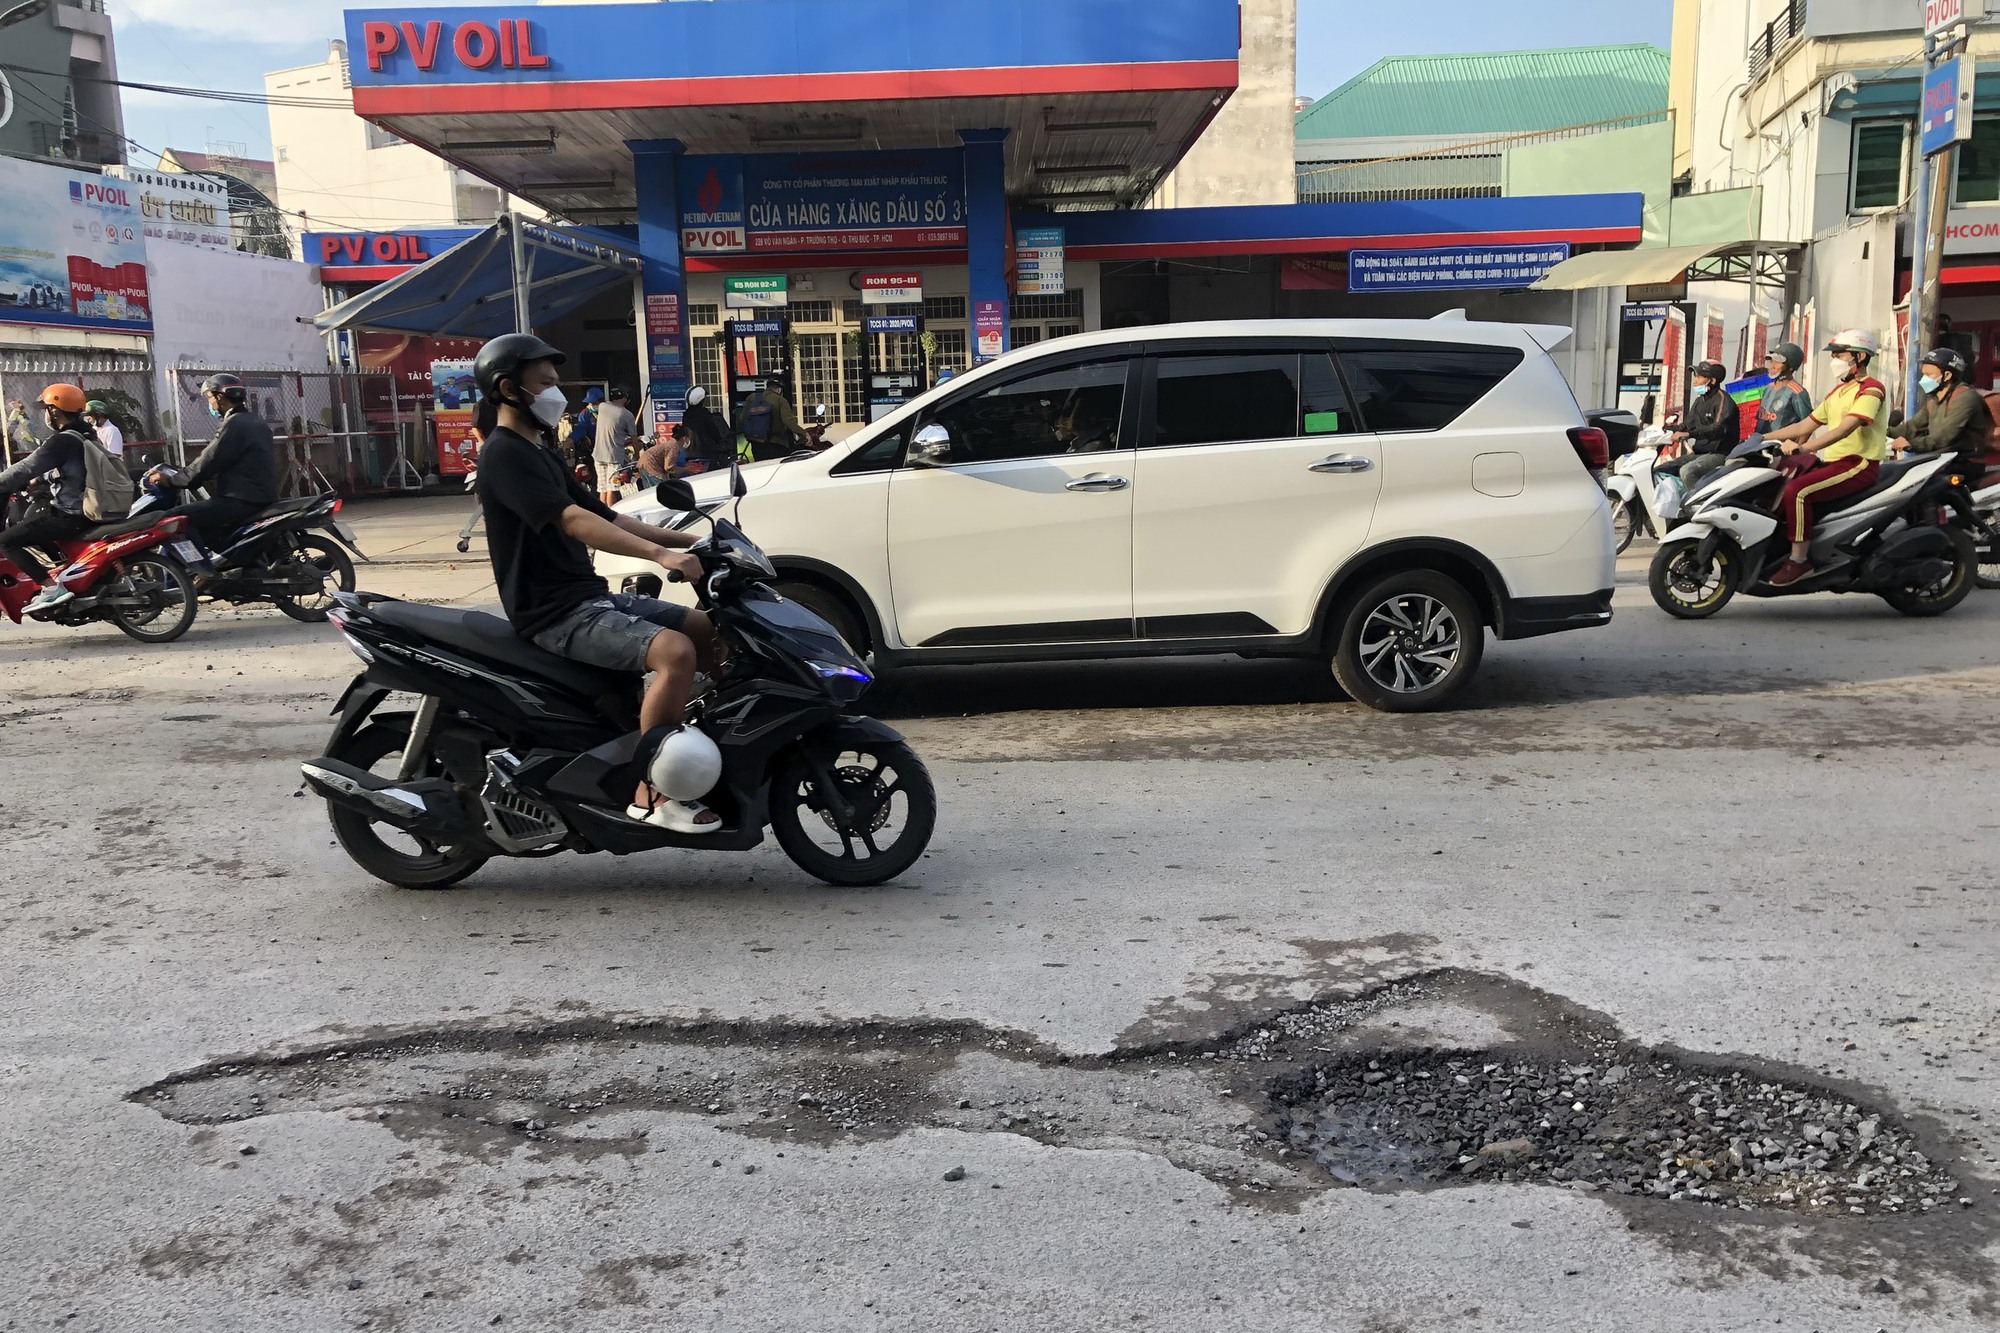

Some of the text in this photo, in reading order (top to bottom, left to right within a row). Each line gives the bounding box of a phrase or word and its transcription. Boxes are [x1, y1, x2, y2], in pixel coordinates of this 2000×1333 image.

[1926, 0, 1959, 30] PVOIL
[364, 19, 549, 71] PV OIL
[1926, 78, 1955, 115] PVOIL
[85, 183, 131, 207] PVOIL
[750, 191, 961, 226] CỬA HÀNG XĂNG DẦU SỐ 3
[684, 211, 741, 223] PETROVIETNAM
[321, 235, 428, 263] PV OIL
[1495, 254, 1502, 263] AN
[1525, 252, 1538, 263] SINH
[1487, 268, 1510, 278] COVID-19
[735, 281, 744, 289] E5
[760, 280, 777, 288] 92-II
[867, 276, 917, 285] RON 95-III
[71, 282, 93, 292] PVOIL
[127, 287, 147, 298] PVOIL
[735, 324, 746, 332] TCCS
[754, 323, 779, 332] 2020/PVOIL
[870, 320, 881, 328] TCCS
[890, 319, 914, 328] 2020/PVOIL
[408, 370, 422, 380] TÀI
